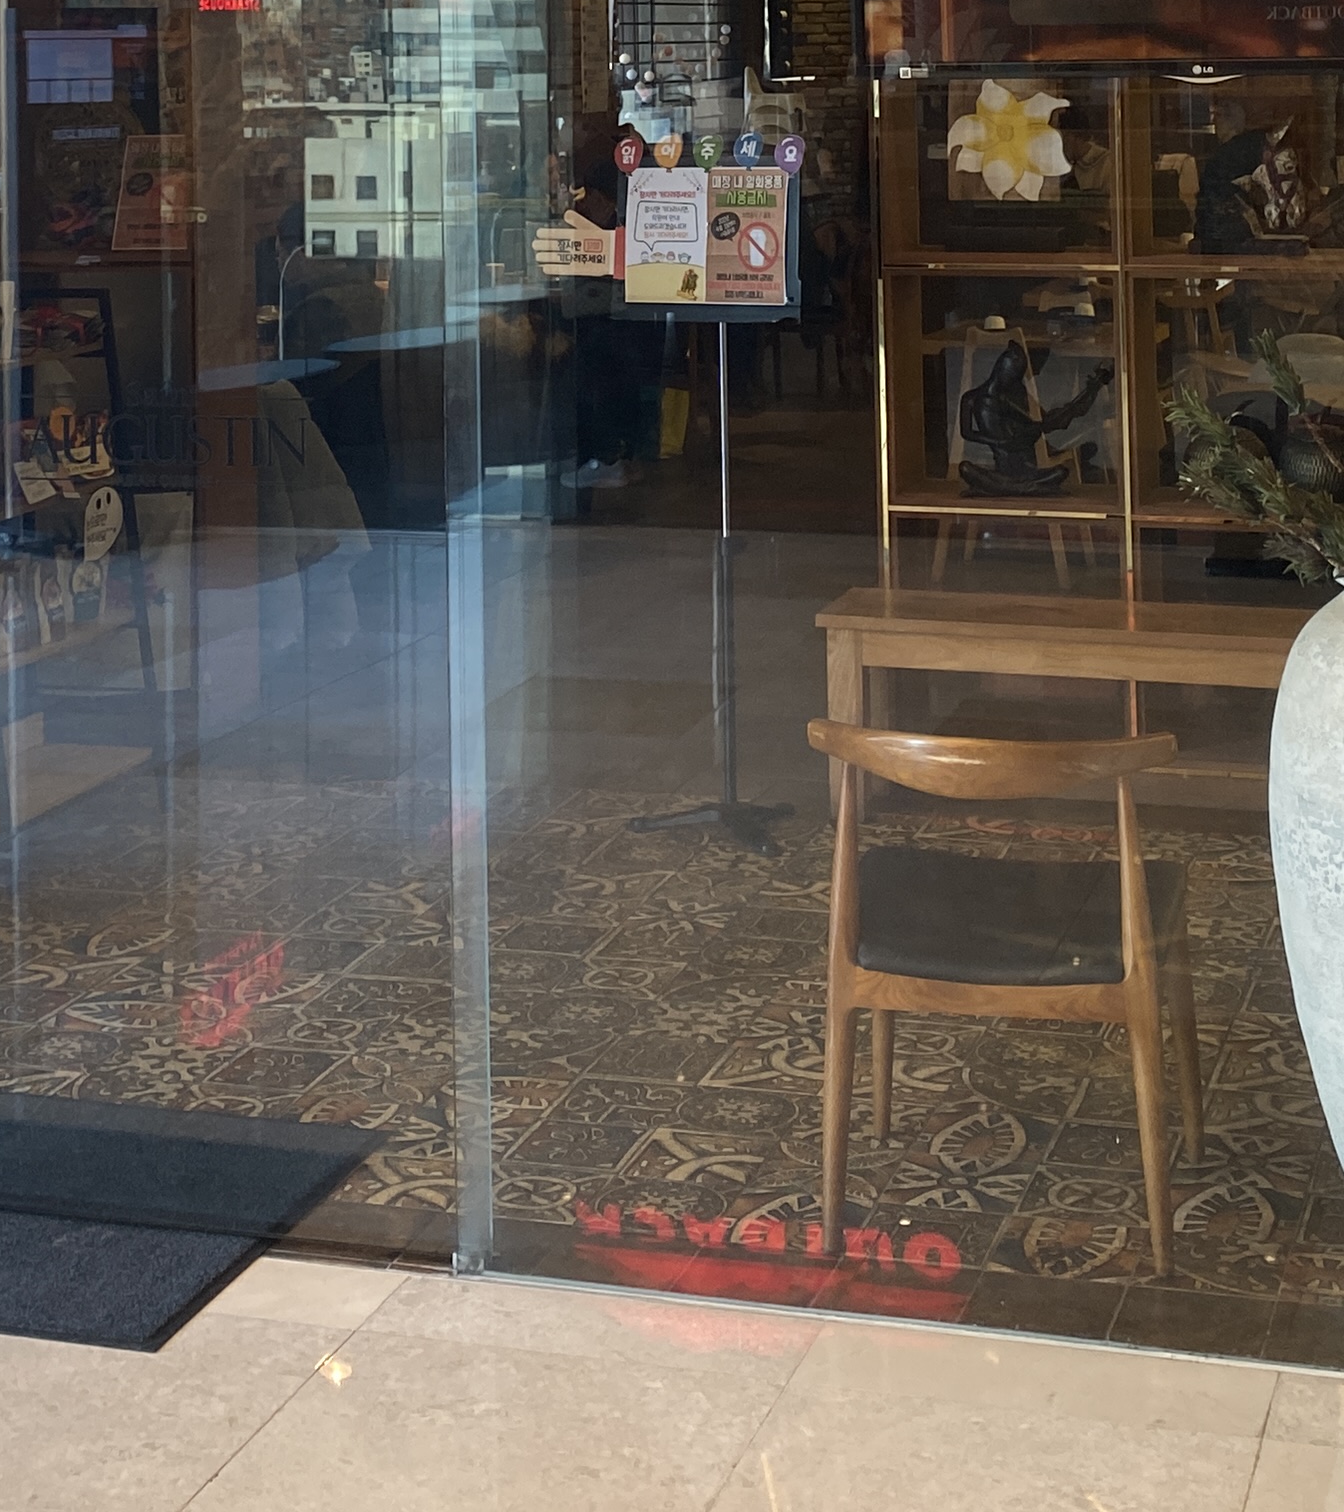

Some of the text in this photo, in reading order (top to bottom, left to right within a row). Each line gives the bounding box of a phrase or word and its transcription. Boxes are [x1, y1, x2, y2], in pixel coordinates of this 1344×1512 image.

[711, 175, 784, 190] 매장 내 일회용품
[725, 190, 769, 206] 사용금지
[557, 240, 582, 252] 잠시만
[25, 413, 311, 468] AUGUSTIN
